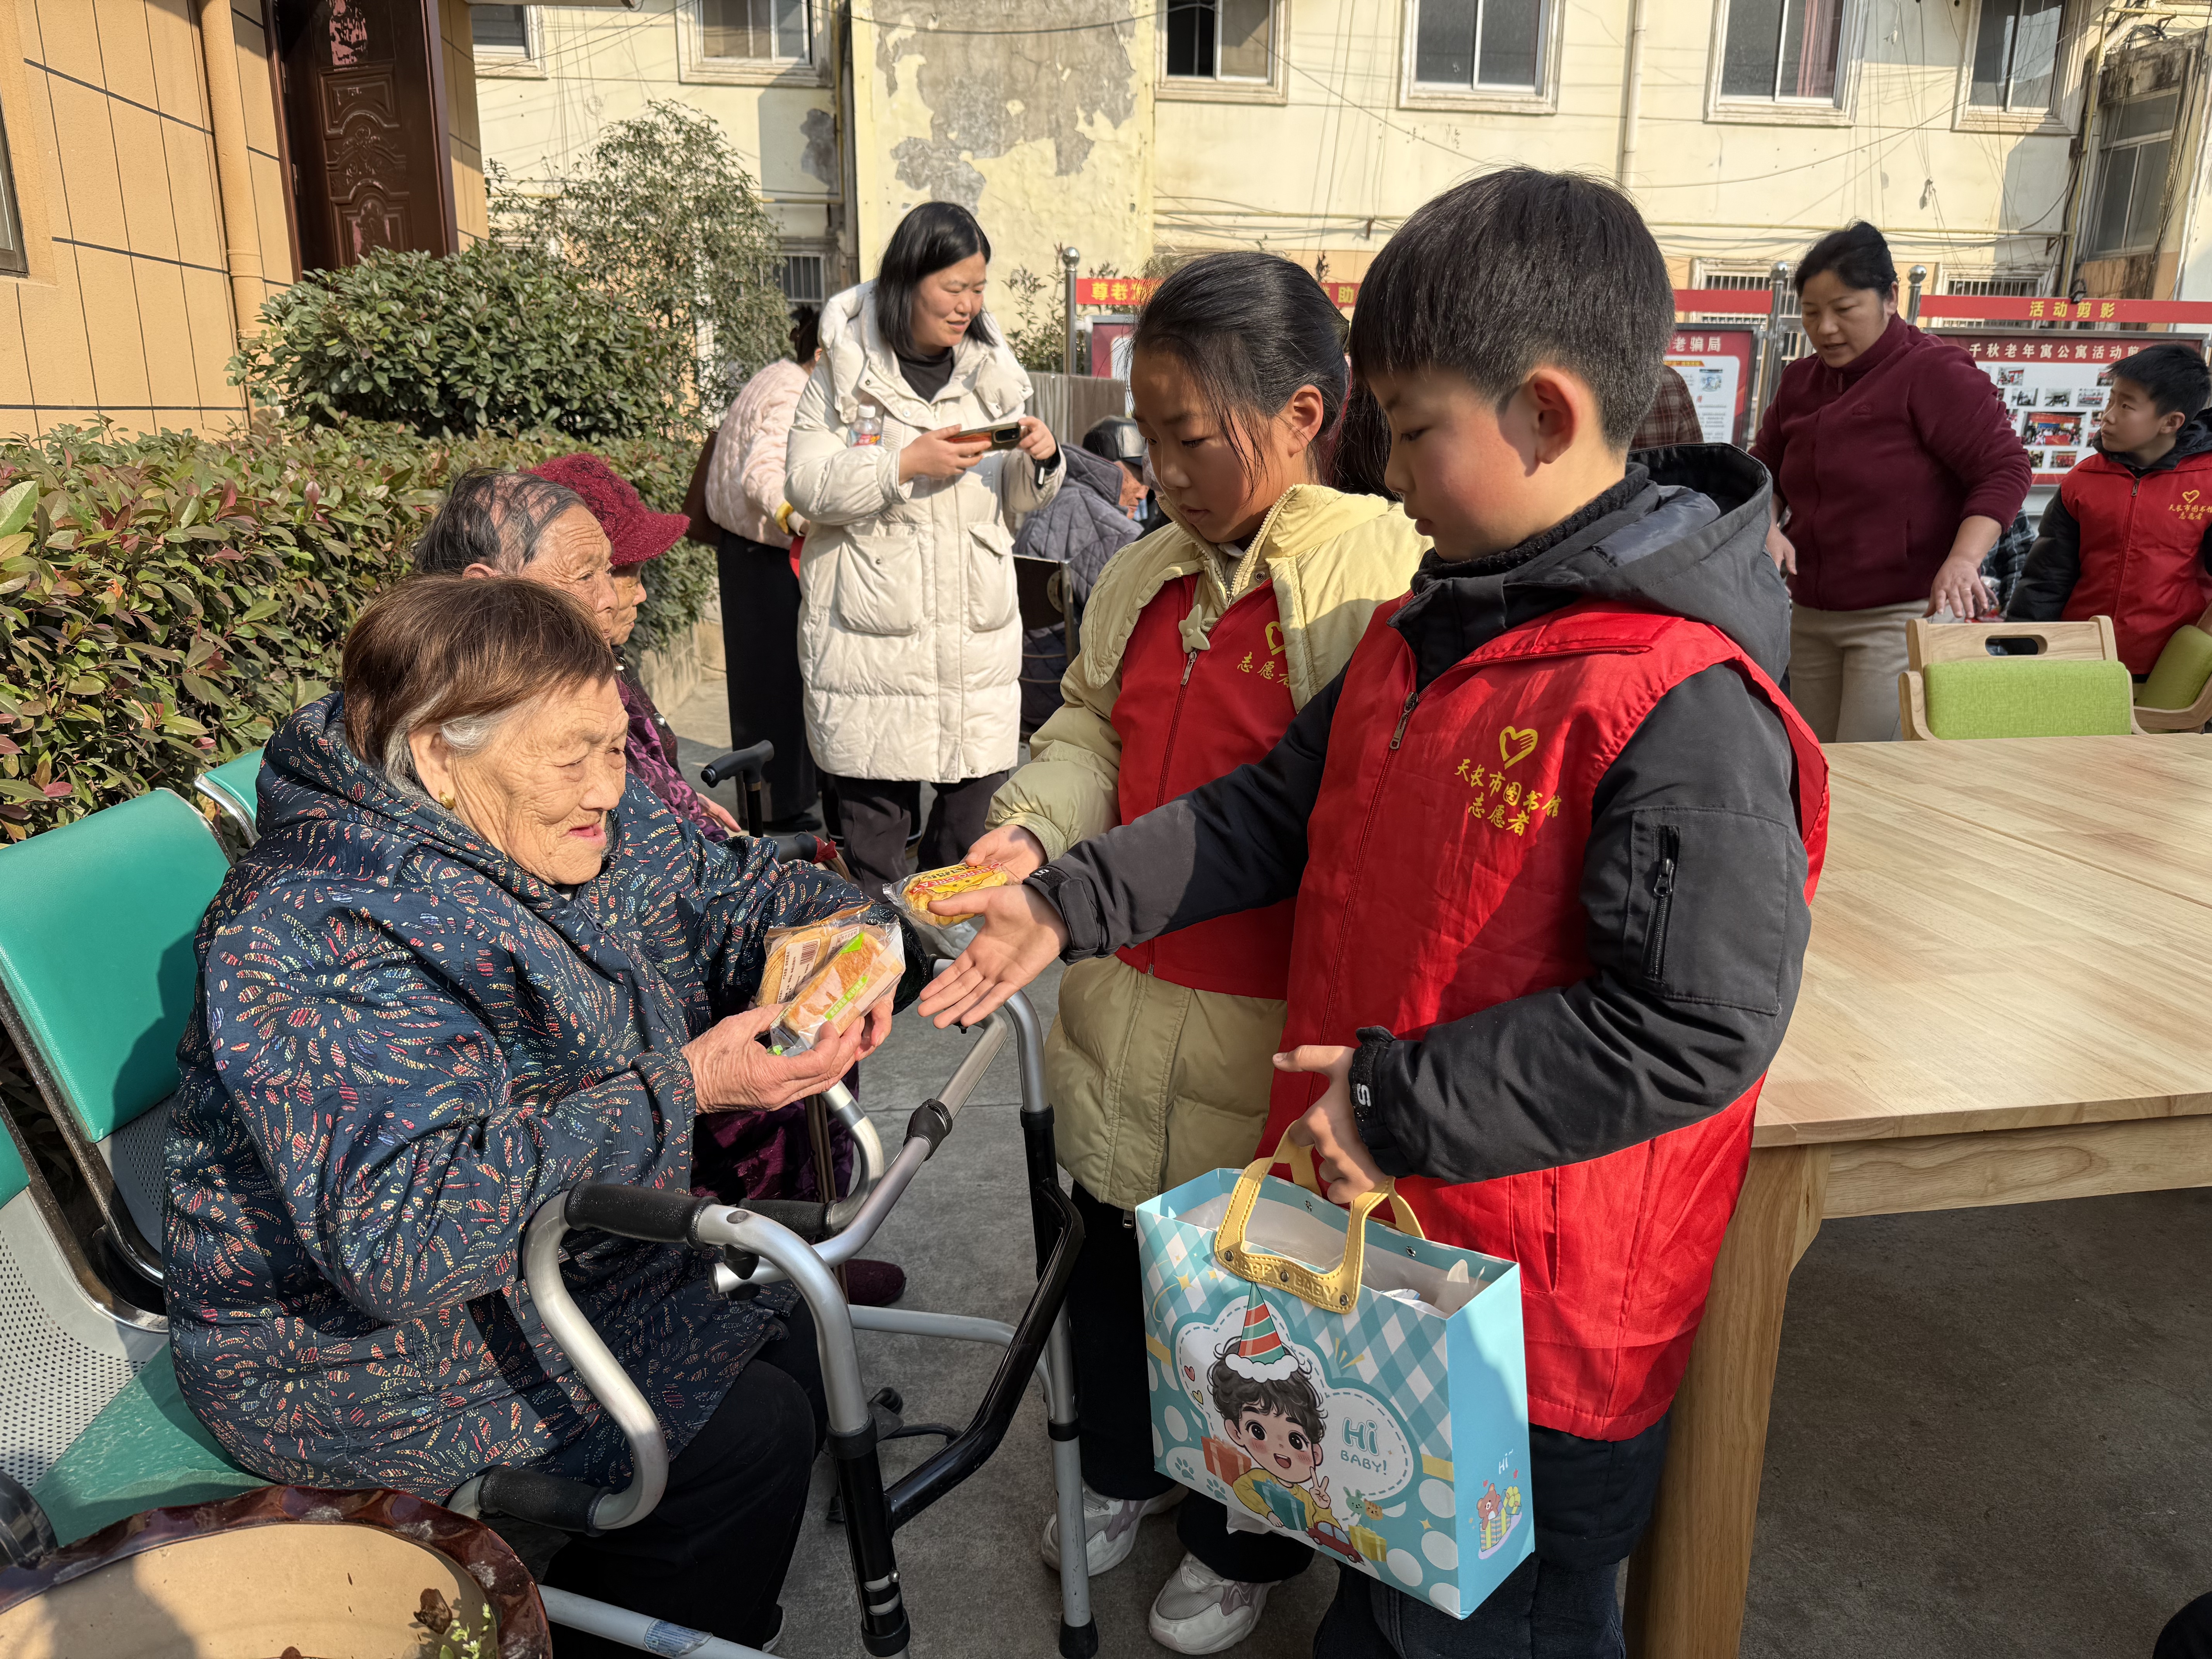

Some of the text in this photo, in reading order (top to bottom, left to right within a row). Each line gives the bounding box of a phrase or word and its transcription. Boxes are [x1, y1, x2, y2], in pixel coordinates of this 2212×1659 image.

[2029, 301, 2116, 318] 活动剪影
[1455, 758, 1562, 818] 天长市图书馆
[1468, 792, 1530, 836] 志愿者
[1293, 1271, 1338, 1302] BABY
[1342, 1417, 1379, 1456] Hi
[1340, 1449, 1387, 1475] BABY!
